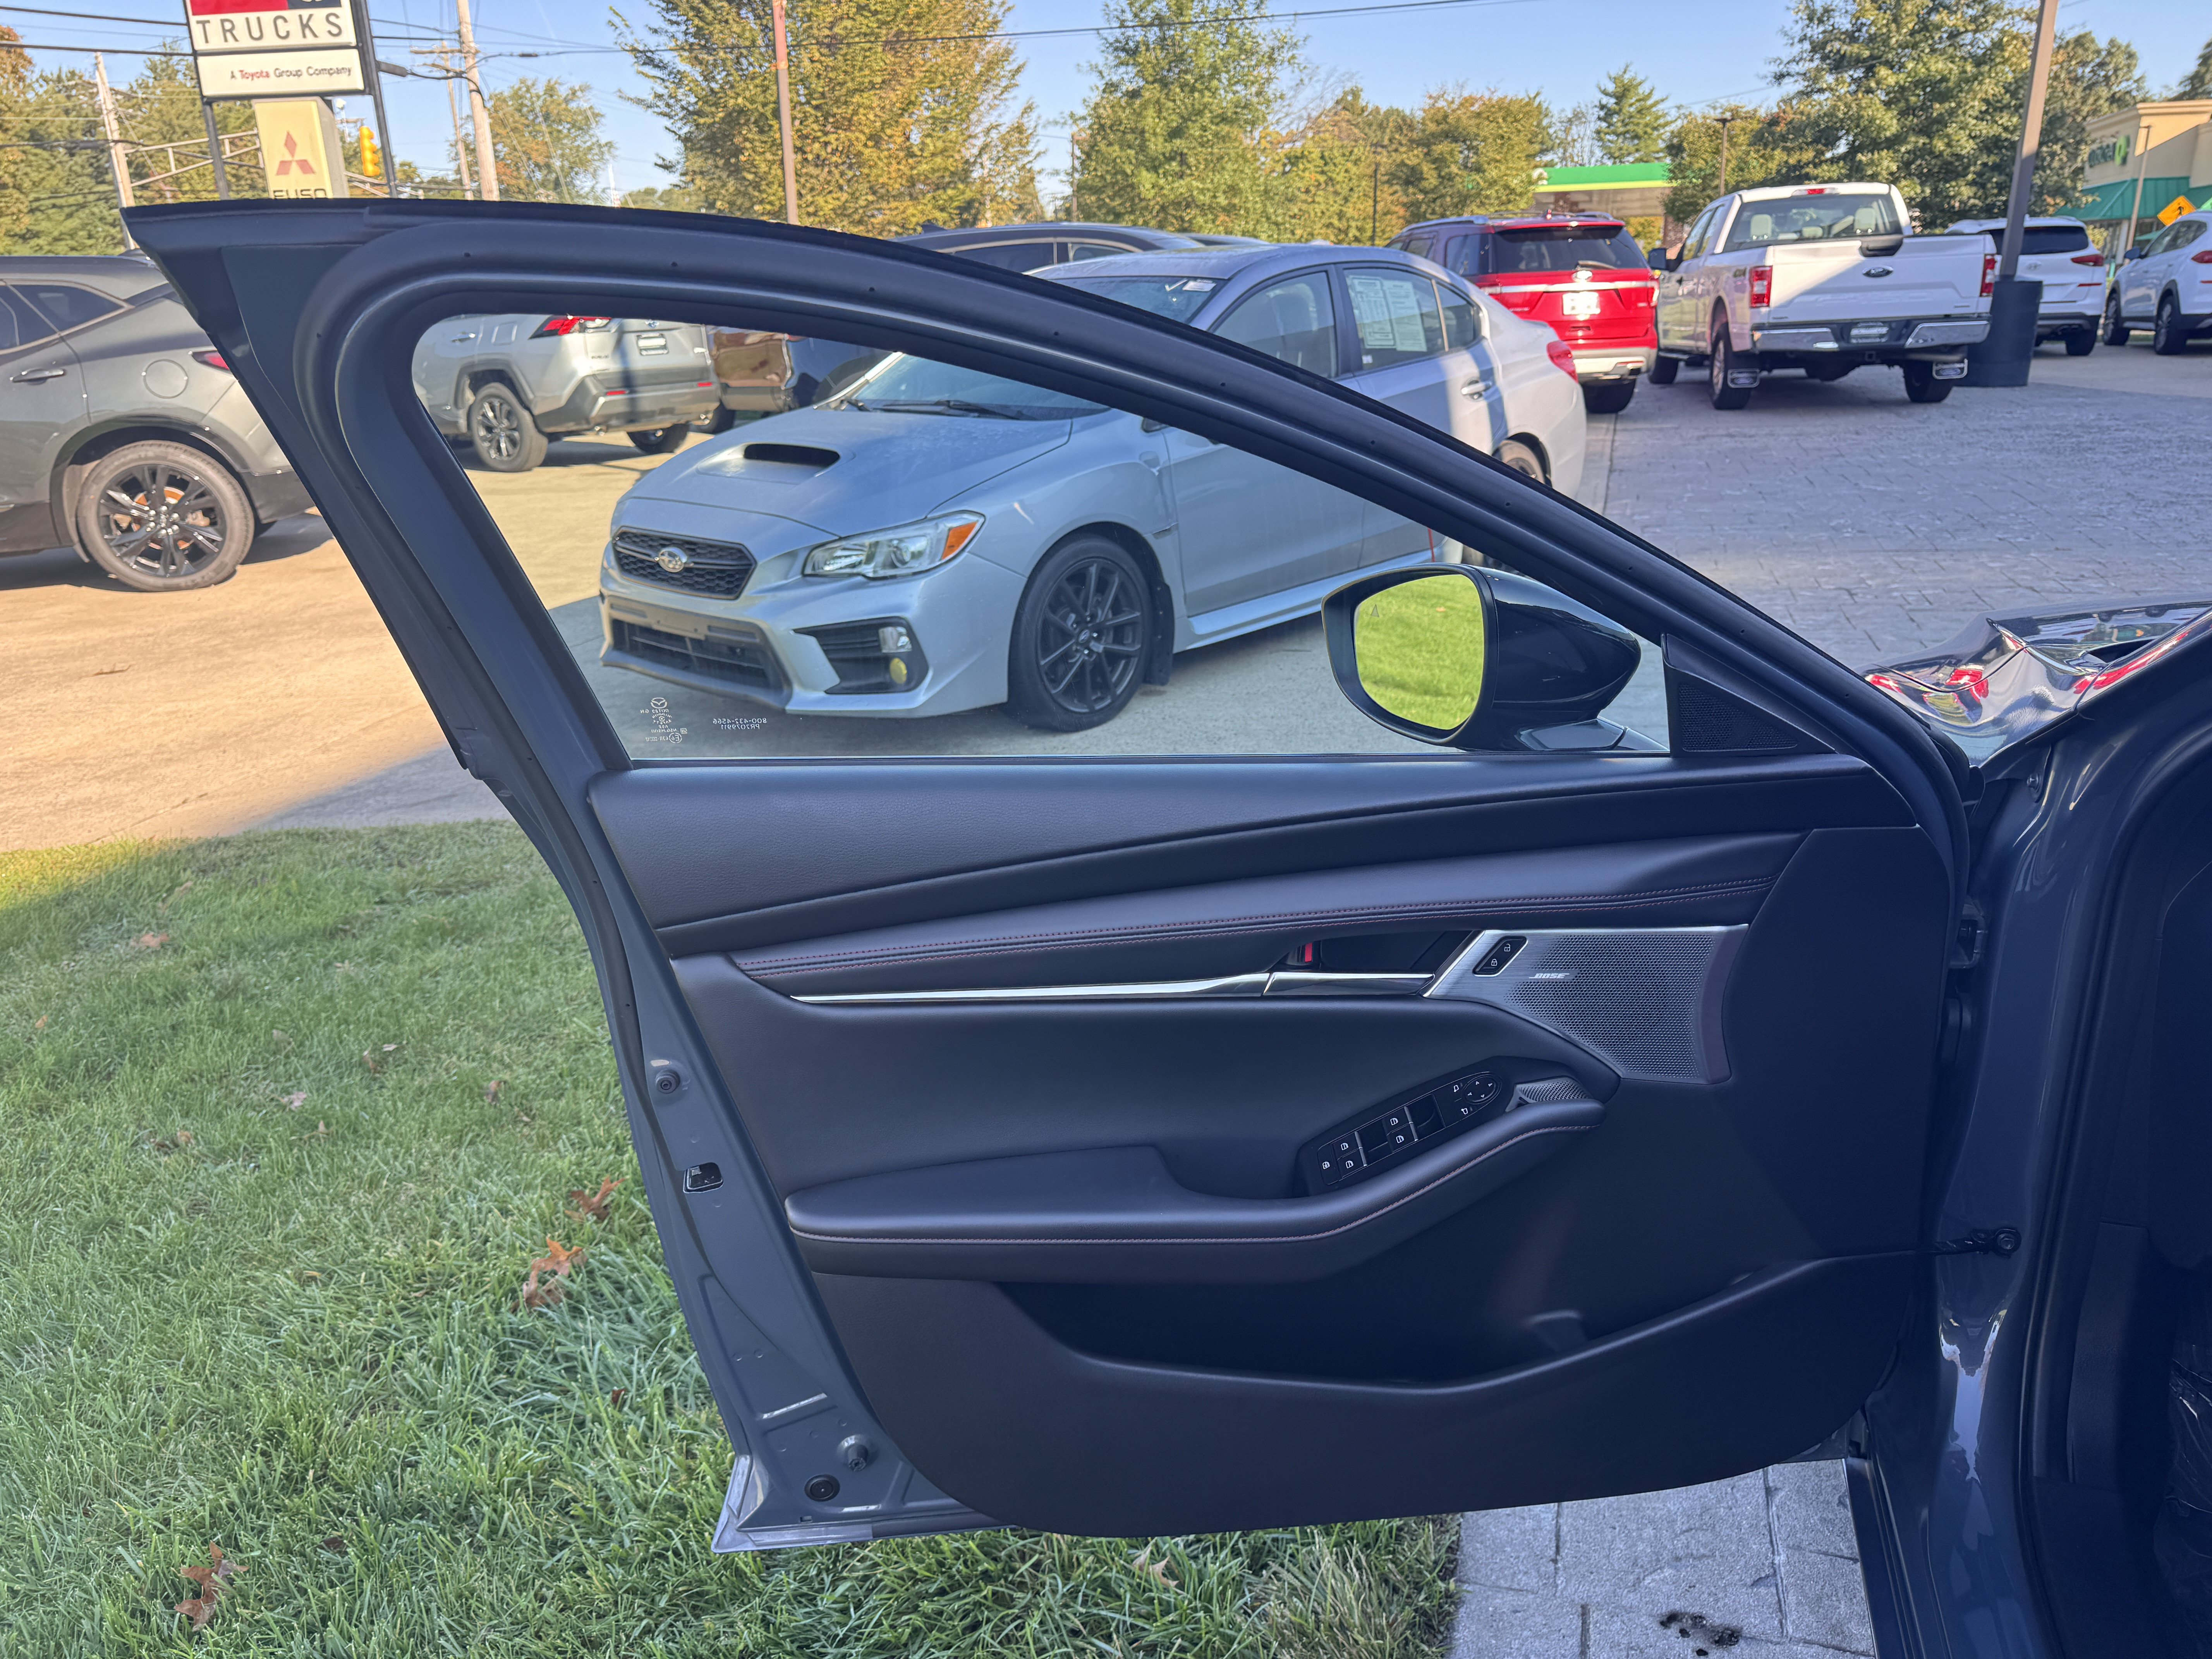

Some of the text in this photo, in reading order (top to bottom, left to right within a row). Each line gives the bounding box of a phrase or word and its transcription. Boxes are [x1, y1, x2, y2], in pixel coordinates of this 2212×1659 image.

[196, 12, 343, 44] TRUCKS
[230, 66, 352, 81] A Toyota Group Company
